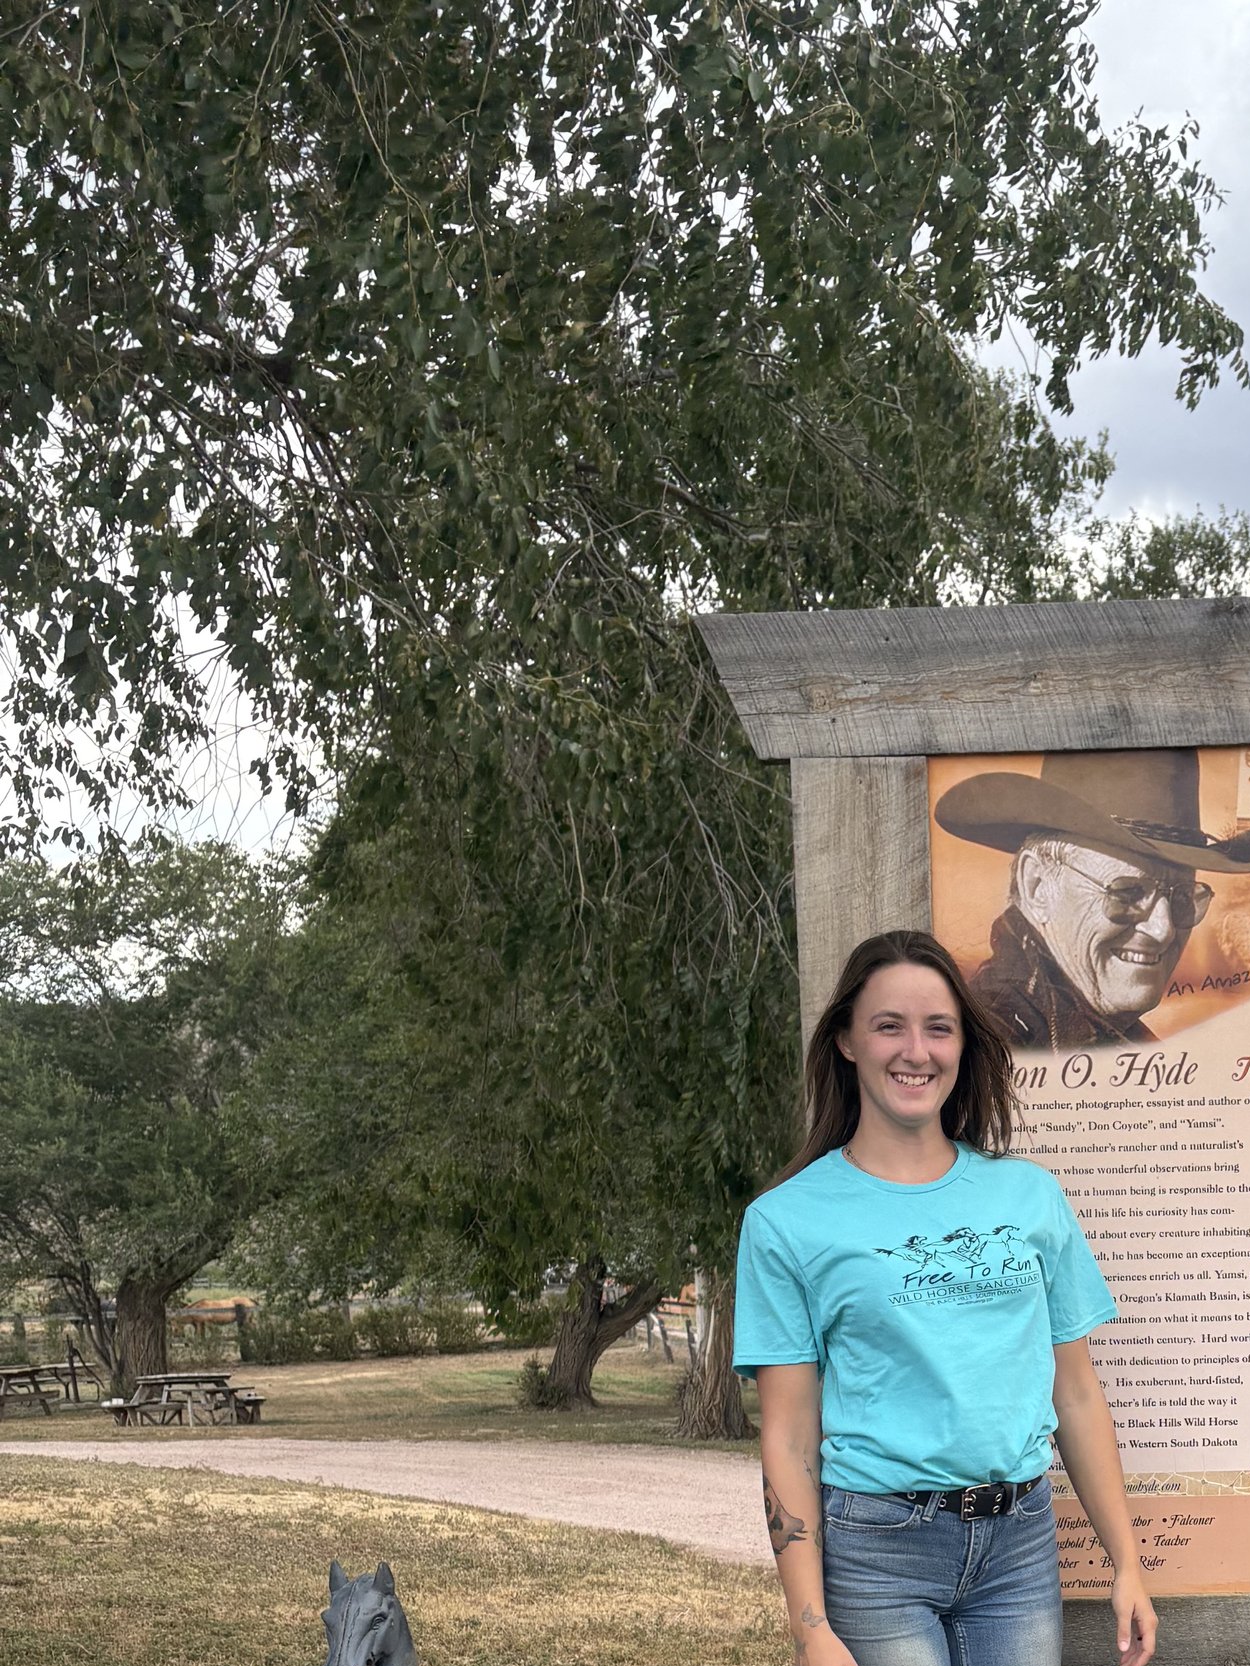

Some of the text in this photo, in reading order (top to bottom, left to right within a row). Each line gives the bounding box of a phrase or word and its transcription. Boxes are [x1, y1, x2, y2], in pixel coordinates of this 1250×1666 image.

[1167, 981, 1194, 998] An
[1014, 1052, 1199, 1092] on O. Hyde
[1031, 1100, 1073, 1112] rancher,
[1075, 1098, 1144, 1111] photographer,
[1146, 1099, 1185, 1109] essayist
[1188, 1097, 1206, 1106] and
[1209, 1096, 1241, 1105] author
[1088, 1122, 1109, 1131] Don
[1159, 1120, 1177, 1129] and
[1030, 1145, 1058, 1154] called
[1119, 1142, 1157, 1152] rancher
[1160, 1142, 1179, 1151] and
[1061, 1166, 1093, 1175] whose
[1096, 1165, 1146, 1174] wonderful
[1148, 1164, 1211, 1173] observations
[1214, 1163, 1240, 1174] bring
[1092, 1186, 1126, 1195] human
[1128, 1186, 1155, 1197] being
[1168, 1184, 1224, 1196] responsible
[1226, 1185, 1236, 1193] to
[1077, 1209, 1092, 1217] All
[1094, 1208, 1109, 1217] his
[1111, 1208, 1127, 1217] life
[1129, 1208, 1144, 1217] his
[1146, 1208, 1188, 1218] curiosity
[1191, 1207, 1208, 1215] has
[1100, 1230, 1127, 1239] about
[1130, 1232, 1157, 1240] every
[1159, 1230, 1200, 1238] creature
[1113, 1251, 1125, 1260] he
[1128, 1251, 1144, 1260] has
[1146, 1250, 1184, 1259] become
[903, 1257, 1031, 1289] Free To Run
[1150, 1271, 1181, 1280] enrich
[1197, 1270, 1213, 1279] all.
[1215, 1270, 1248, 1281] Yamsi,
[888, 1292, 922, 1304] WILD
[927, 1286, 971, 1298] HORSE
[1120, 1293, 1162, 1304] Oregon's
[1166, 1292, 1206, 1301] Klamath
[1209, 1292, 1240, 1302] Basin,
[1162, 1314, 1187, 1323] what
[1089, 1336, 1107, 1345] late
[1109, 1335, 1155, 1345] twentieth
[1157, 1336, 1196, 1346] century.
[1201, 1334, 1228, 1343] Hard
[1105, 1357, 1127, 1366] with
[1129, 1356, 1179, 1365] dedication
[1193, 1355, 1239, 1366] principles
[1116, 1378, 1133, 1386] His
[1135, 1377, 1187, 1388] exuberant,
[1189, 1376, 1244, 1387] hard-fisted,
[1143, 1398, 1156, 1407] life
[1170, 1397, 1187, 1406] told
[1190, 1397, 1205, 1406] the
[1208, 1399, 1228, 1407] way
[1128, 1419, 1157, 1428] Black
[1159, 1418, 1181, 1427] Hills
[1184, 1418, 1207, 1427] Wild
[1210, 1417, 1239, 1426] Horse
[1128, 1439, 1168, 1448] Western
[1170, 1439, 1199, 1447] South
[1202, 1438, 1238, 1447] Dakota
[1132, 1516, 1153, 1526] thor
[1168, 1514, 1215, 1528] Falconer
[1154, 1534, 1191, 1546] Teacher
[1140, 1556, 1166, 1571] Rider
